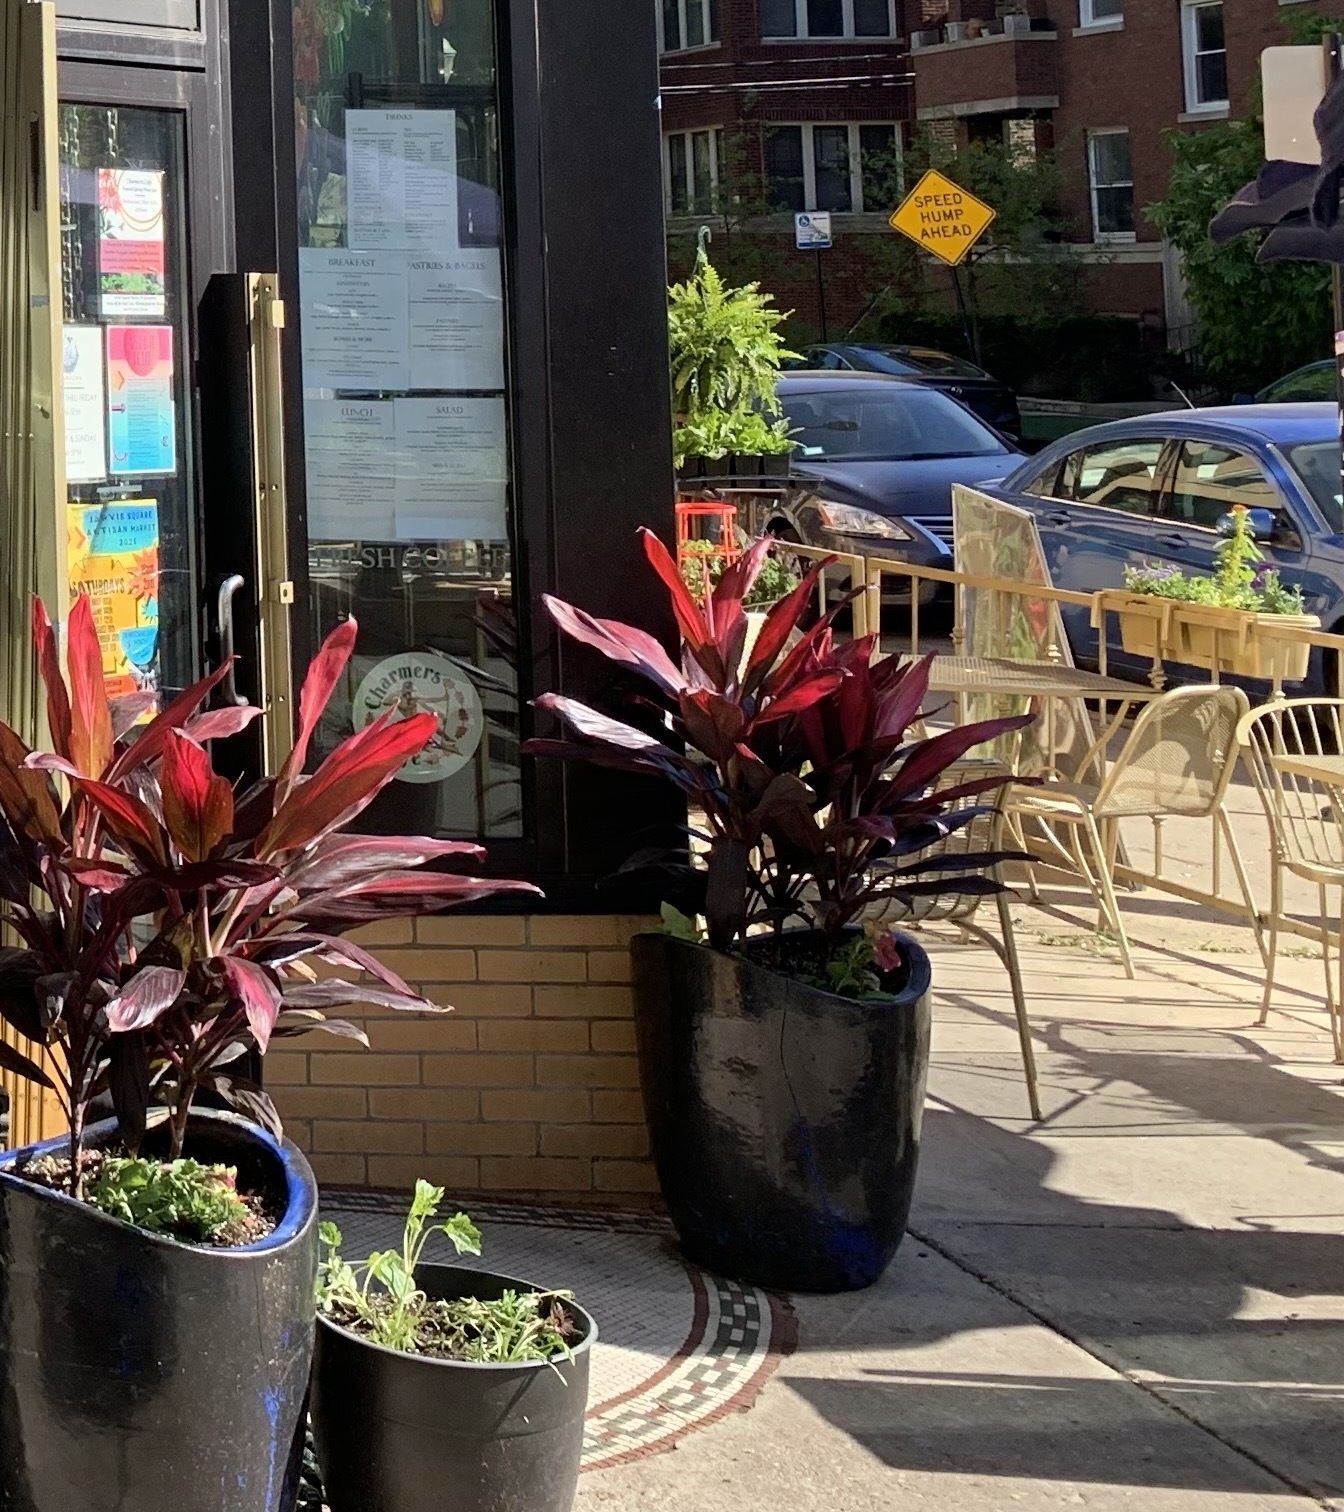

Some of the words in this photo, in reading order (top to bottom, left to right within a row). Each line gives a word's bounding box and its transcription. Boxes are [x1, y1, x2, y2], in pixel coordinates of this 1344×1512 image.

[914, 193, 962, 208] SPEED
[920, 209, 964, 223] HUMP
[921, 224, 972, 240] AHEAD
[328, 258, 376, 267] BREAKFAST
[341, 407, 373, 417] LUNCH
[435, 406, 463, 415] SALAD
[364, 665, 442, 710] Charmers
